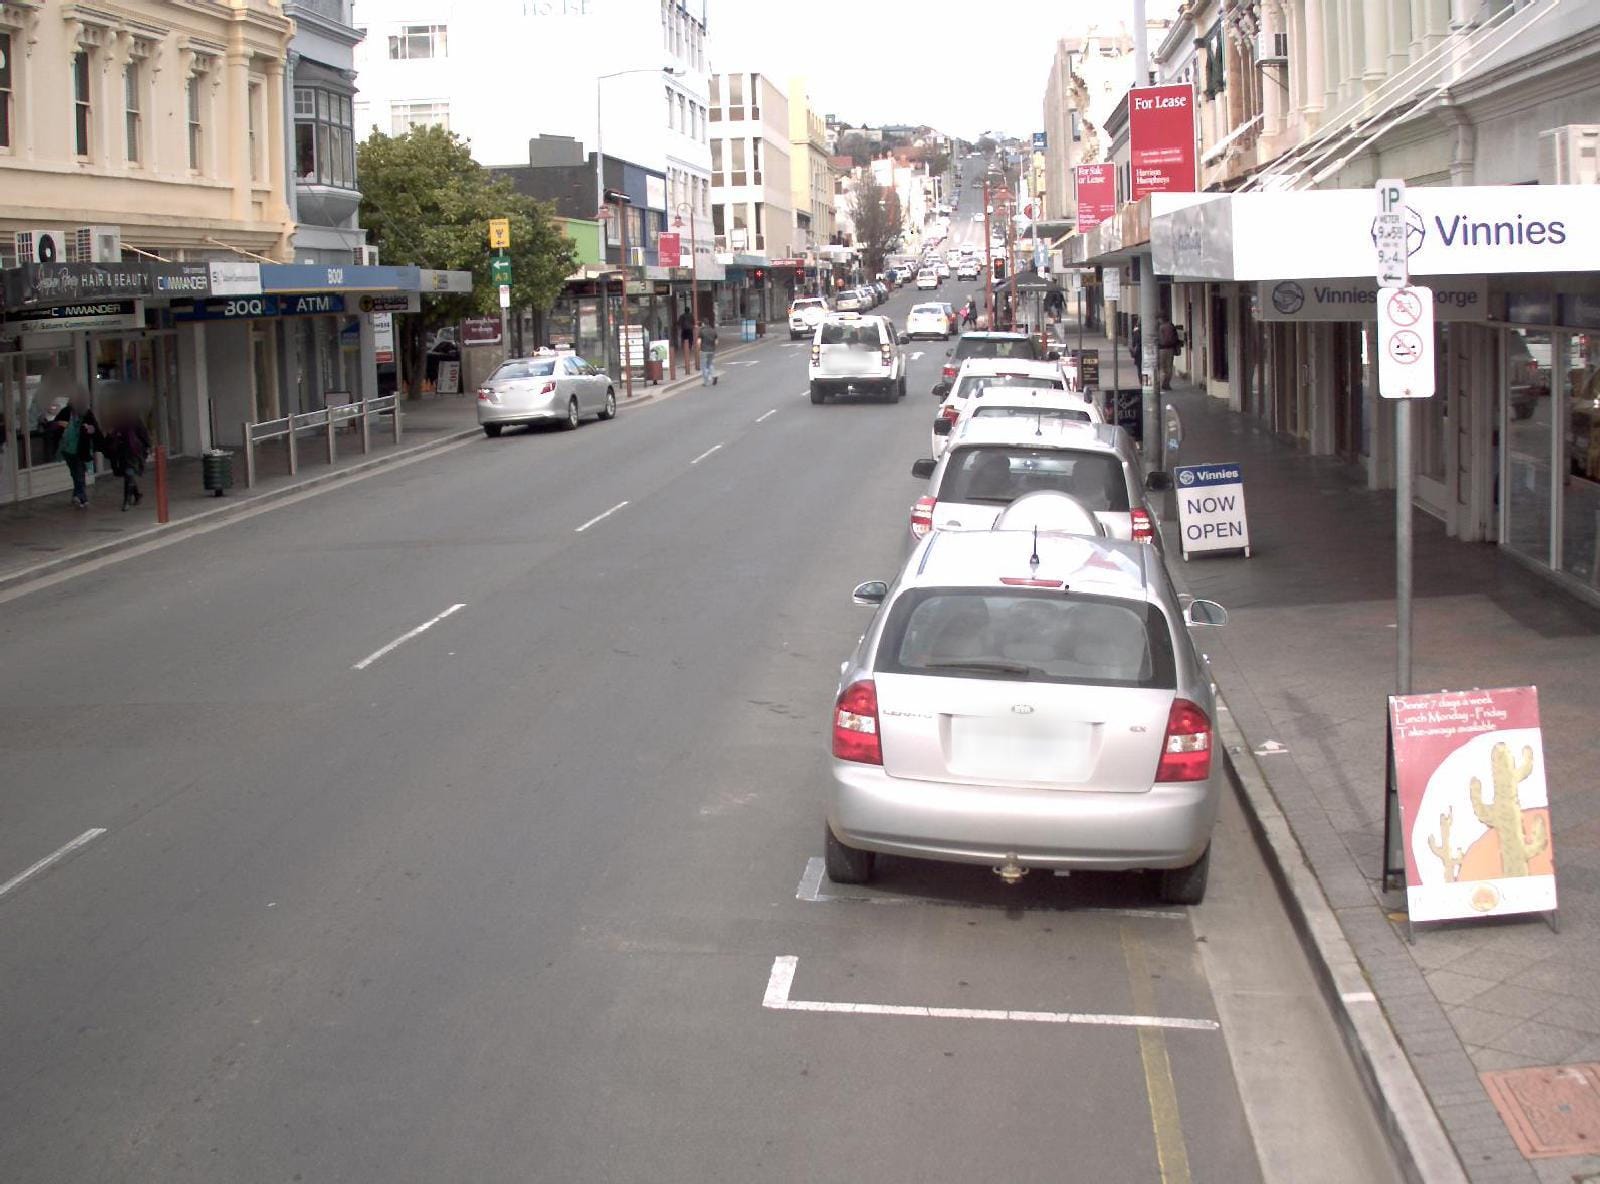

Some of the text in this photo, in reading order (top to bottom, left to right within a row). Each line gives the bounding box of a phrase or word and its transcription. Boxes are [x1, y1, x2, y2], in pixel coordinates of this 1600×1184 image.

[1135, 95, 1187, 110] For Lease
[1381, 187, 1400, 213] 1P
[1434, 213, 1567, 247] Vinnies
[81, 273, 148, 287] HAIR & BEAUTY
[224, 296, 329, 316] BOQ ATM
[1314, 286, 1477, 308] Vinnies orge
[1196, 469, 1239, 481] Vinnies
[1187, 496, 1235, 514] NOW
[1187, 521, 1242, 540] OPEN
[1439, 696, 1461, 711] days
[1395, 711, 1428, 726] Lunch
[1428, 709, 1469, 723] Monday
[1475, 707, 1507, 720] Friday
